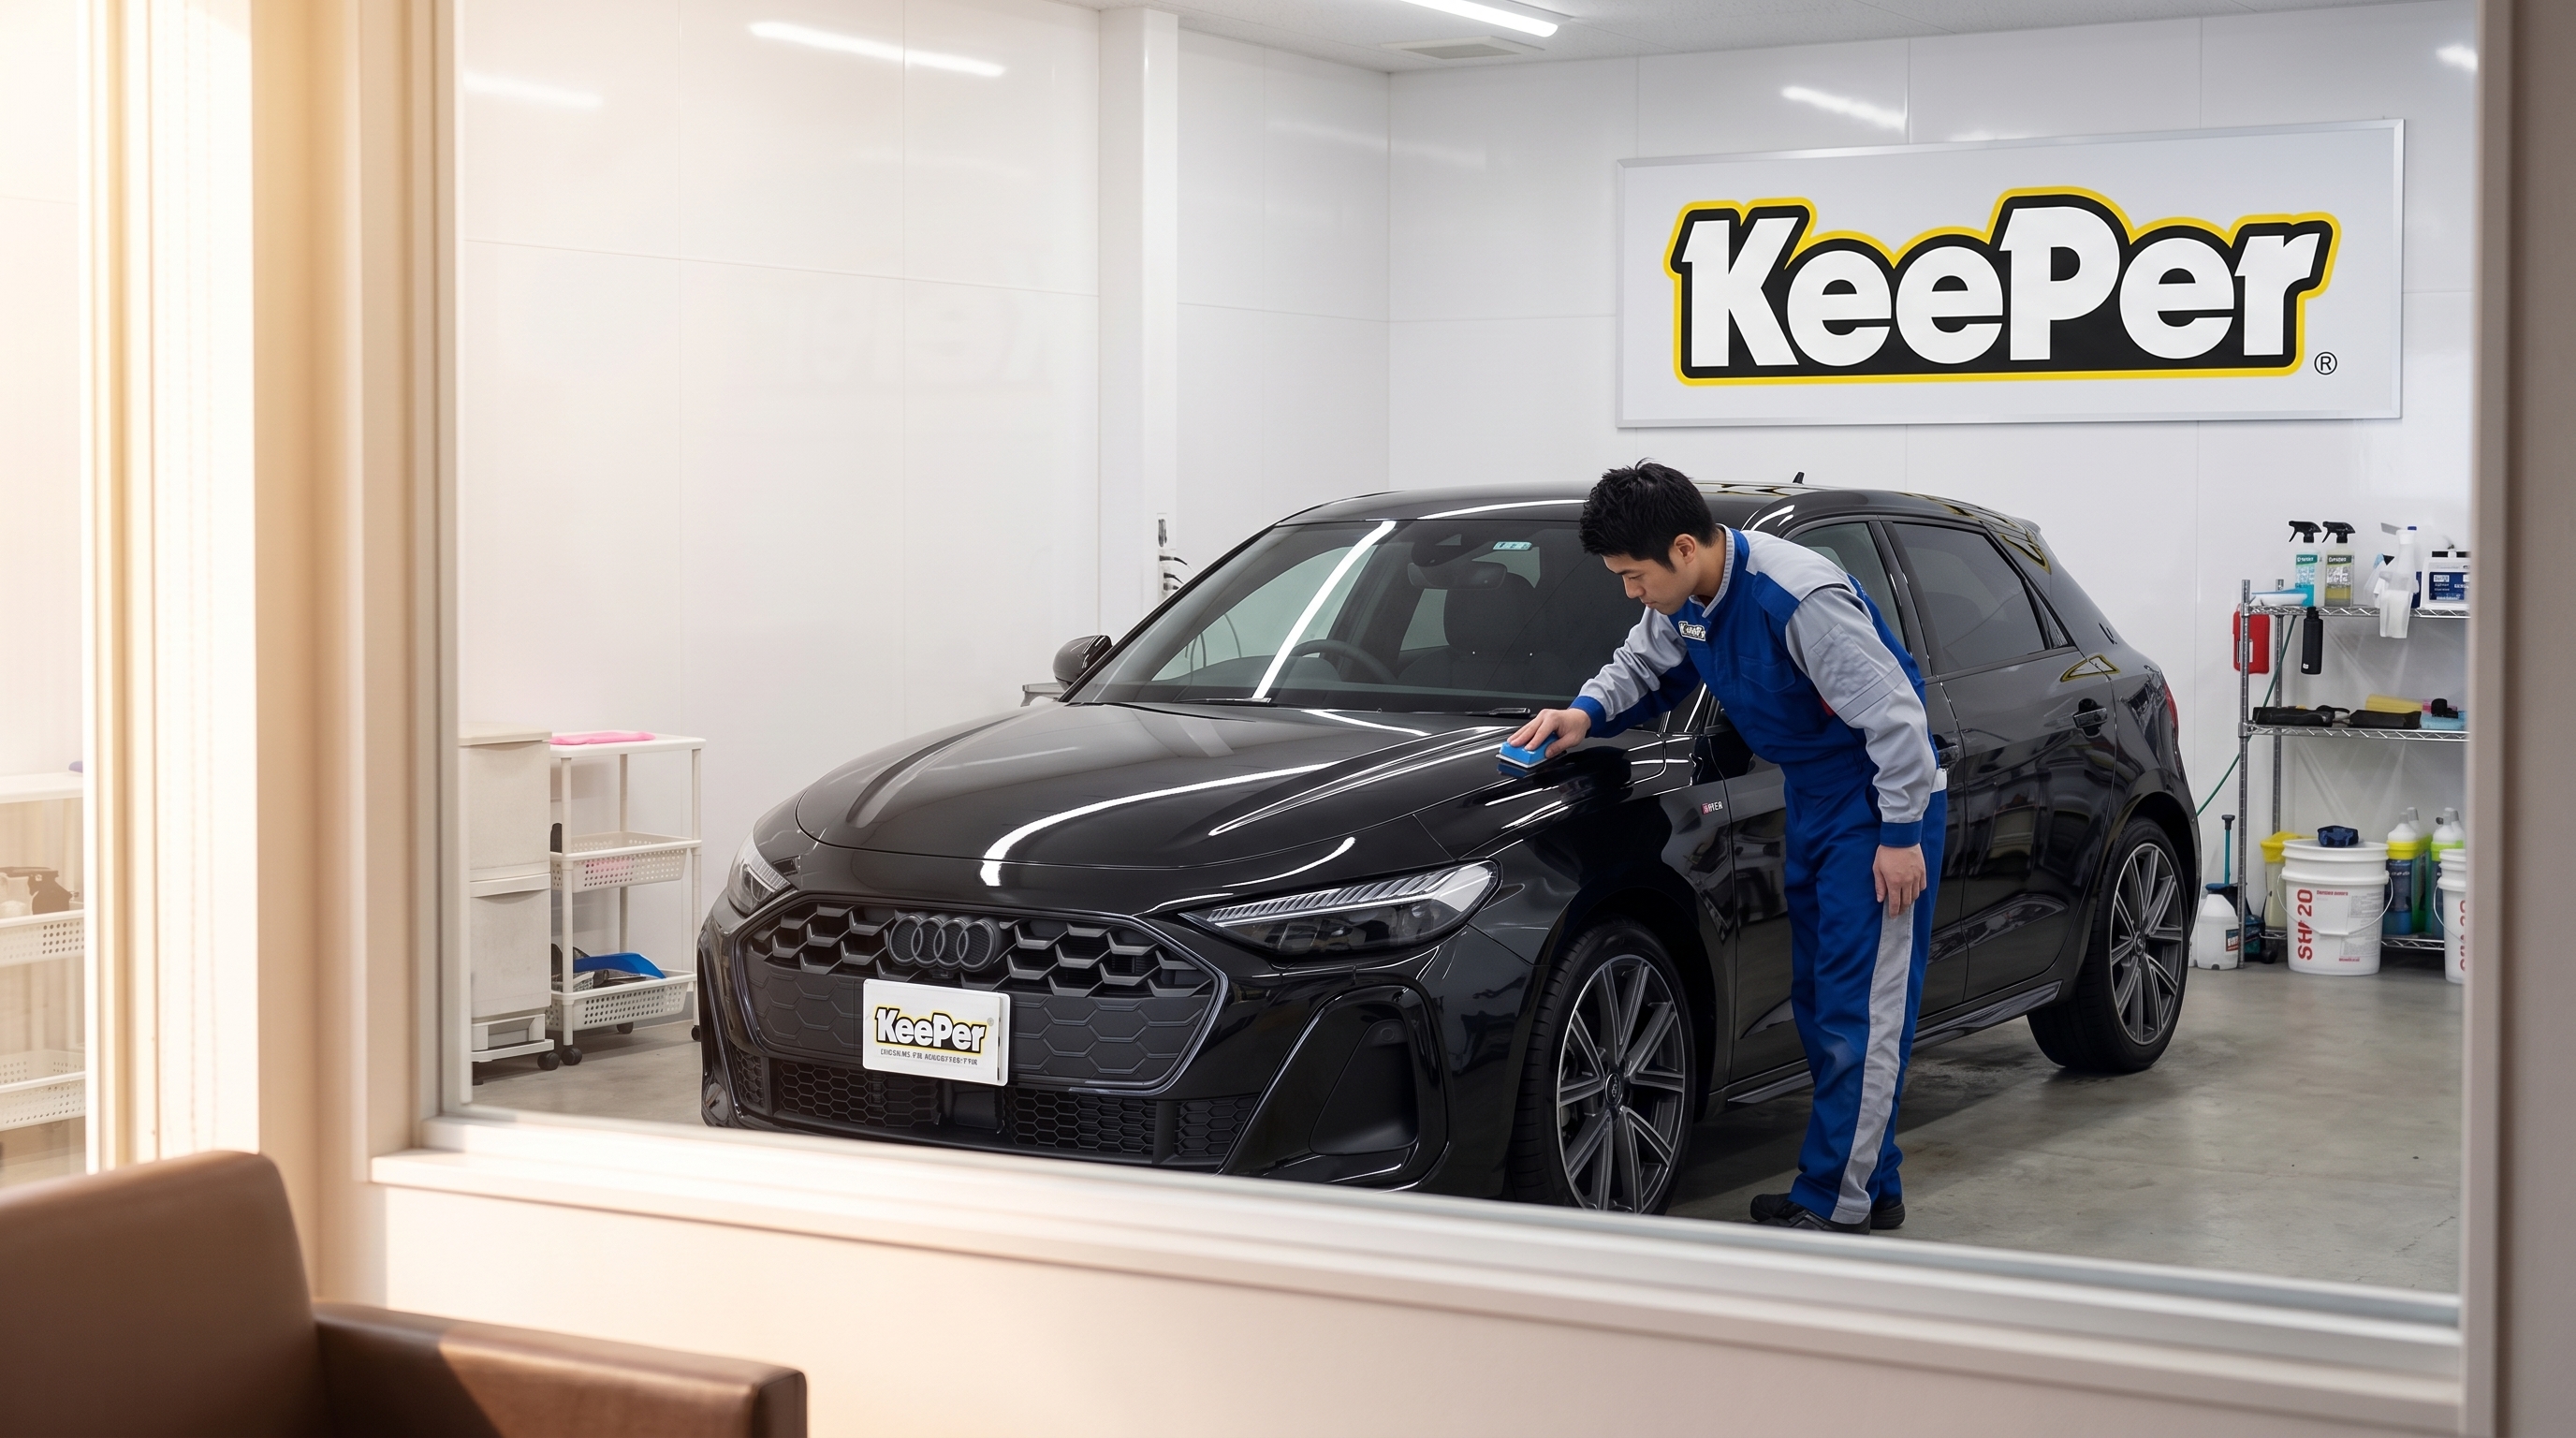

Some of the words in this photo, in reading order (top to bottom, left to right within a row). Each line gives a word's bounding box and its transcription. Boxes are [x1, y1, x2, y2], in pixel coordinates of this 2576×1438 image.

[1673, 195, 2331, 376] KeePer
[2297, 888, 2313, 917] 20
[875, 1006, 987, 1053] KeePer
